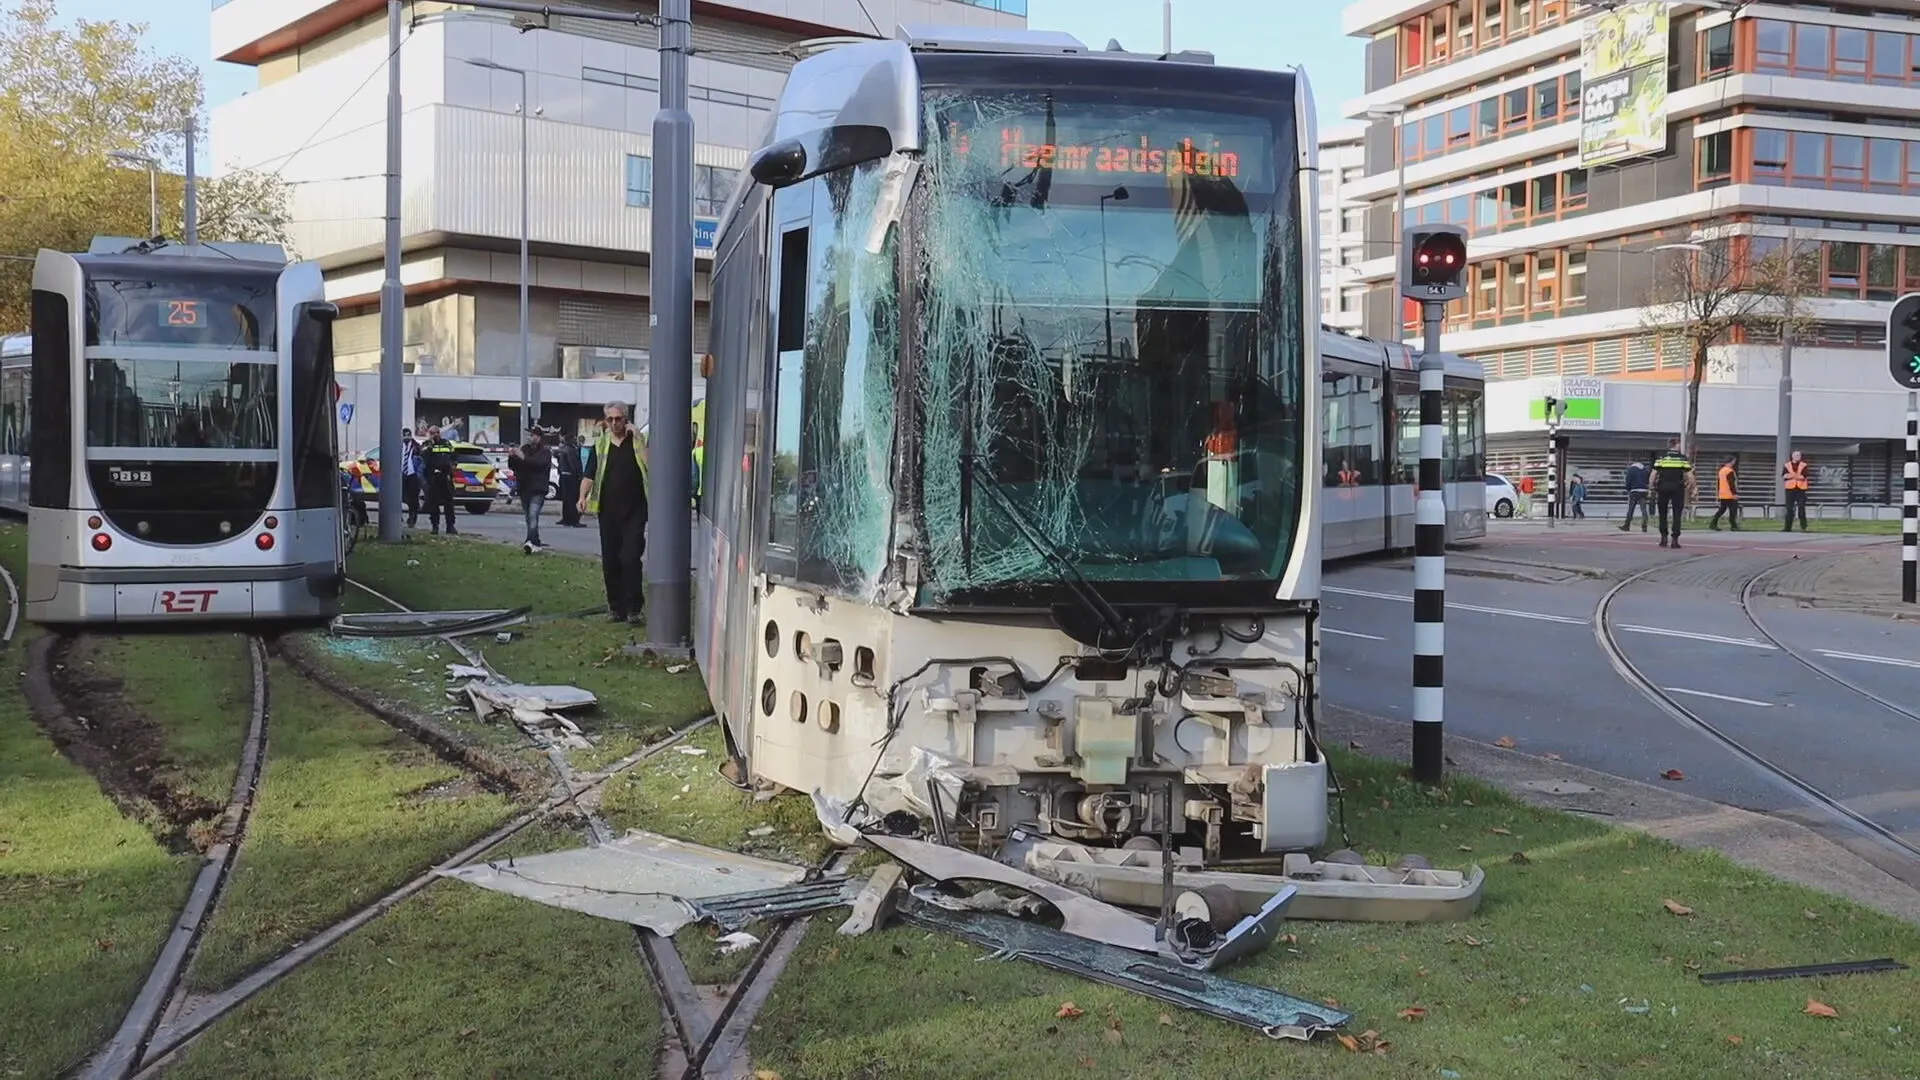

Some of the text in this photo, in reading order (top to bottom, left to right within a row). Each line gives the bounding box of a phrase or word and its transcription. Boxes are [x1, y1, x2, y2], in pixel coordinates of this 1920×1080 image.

[1585, 76, 1630, 104] OPEN
[1584, 99, 1615, 121] DAG
[168, 301, 197, 325] 25
[1563, 387, 1601, 397] LYCEUM
[111, 472, 150, 480] 9292
[160, 590, 219, 613] RET
